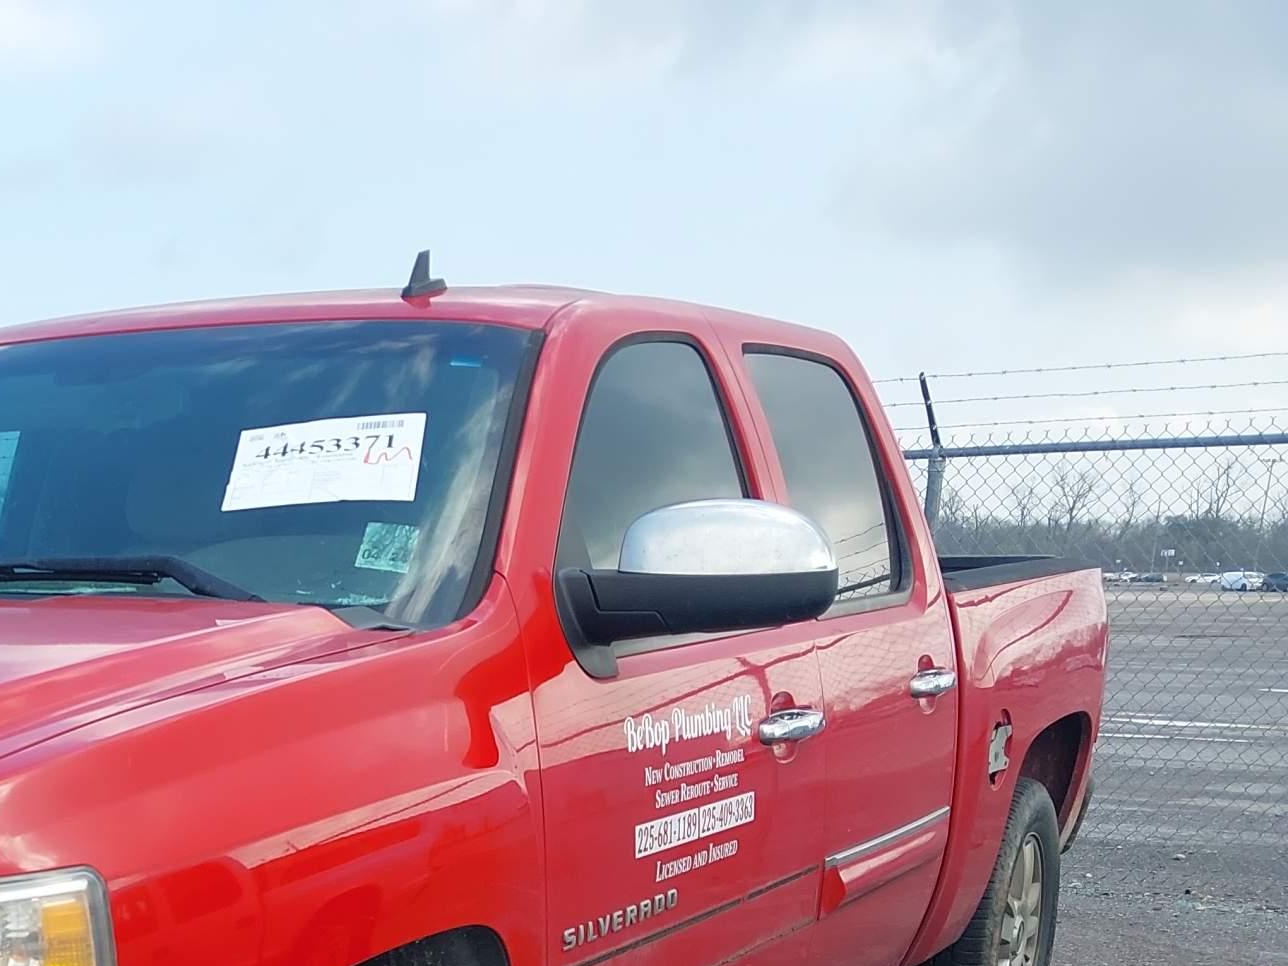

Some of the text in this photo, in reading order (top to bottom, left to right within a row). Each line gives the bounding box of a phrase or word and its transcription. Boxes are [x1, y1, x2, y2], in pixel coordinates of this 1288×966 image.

[255, 433, 395, 460] 44453371
[623, 694, 754, 757] BeBop Plumbing LLC
[637, 811, 698, 854] 225-681-1189
[562, 888, 679, 952] SILVERADO
